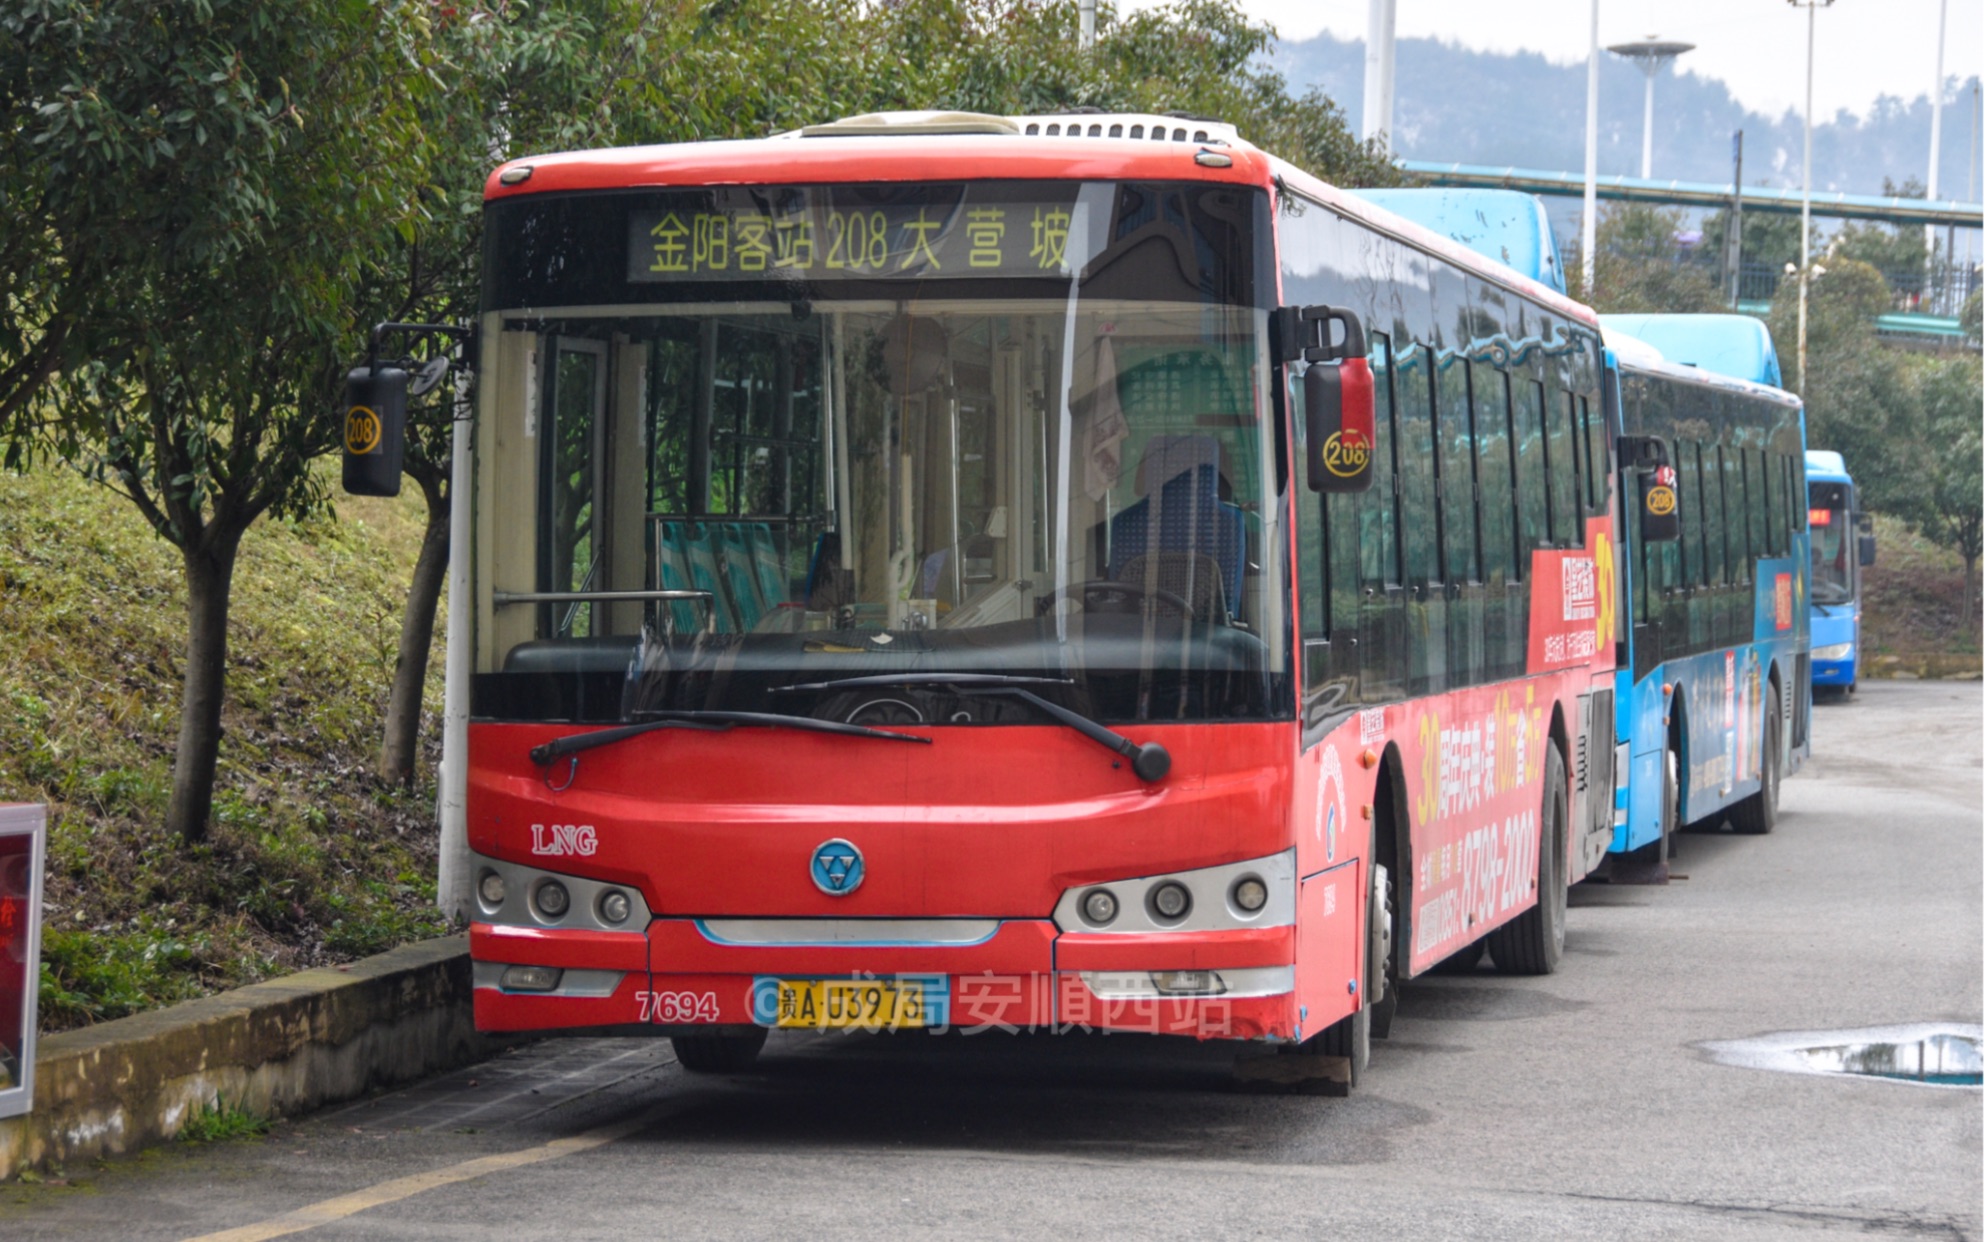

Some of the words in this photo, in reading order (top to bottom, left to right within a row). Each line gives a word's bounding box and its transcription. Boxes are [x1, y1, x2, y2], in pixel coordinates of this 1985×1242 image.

[649, 210, 814, 273] 金阳客站
[827, 210, 887, 270] 208
[349, 417, 373, 443] 208
[1329, 441, 1365, 465] 208
[531, 824, 598, 856] LNG
[636, 991, 720, 1022] 7694
